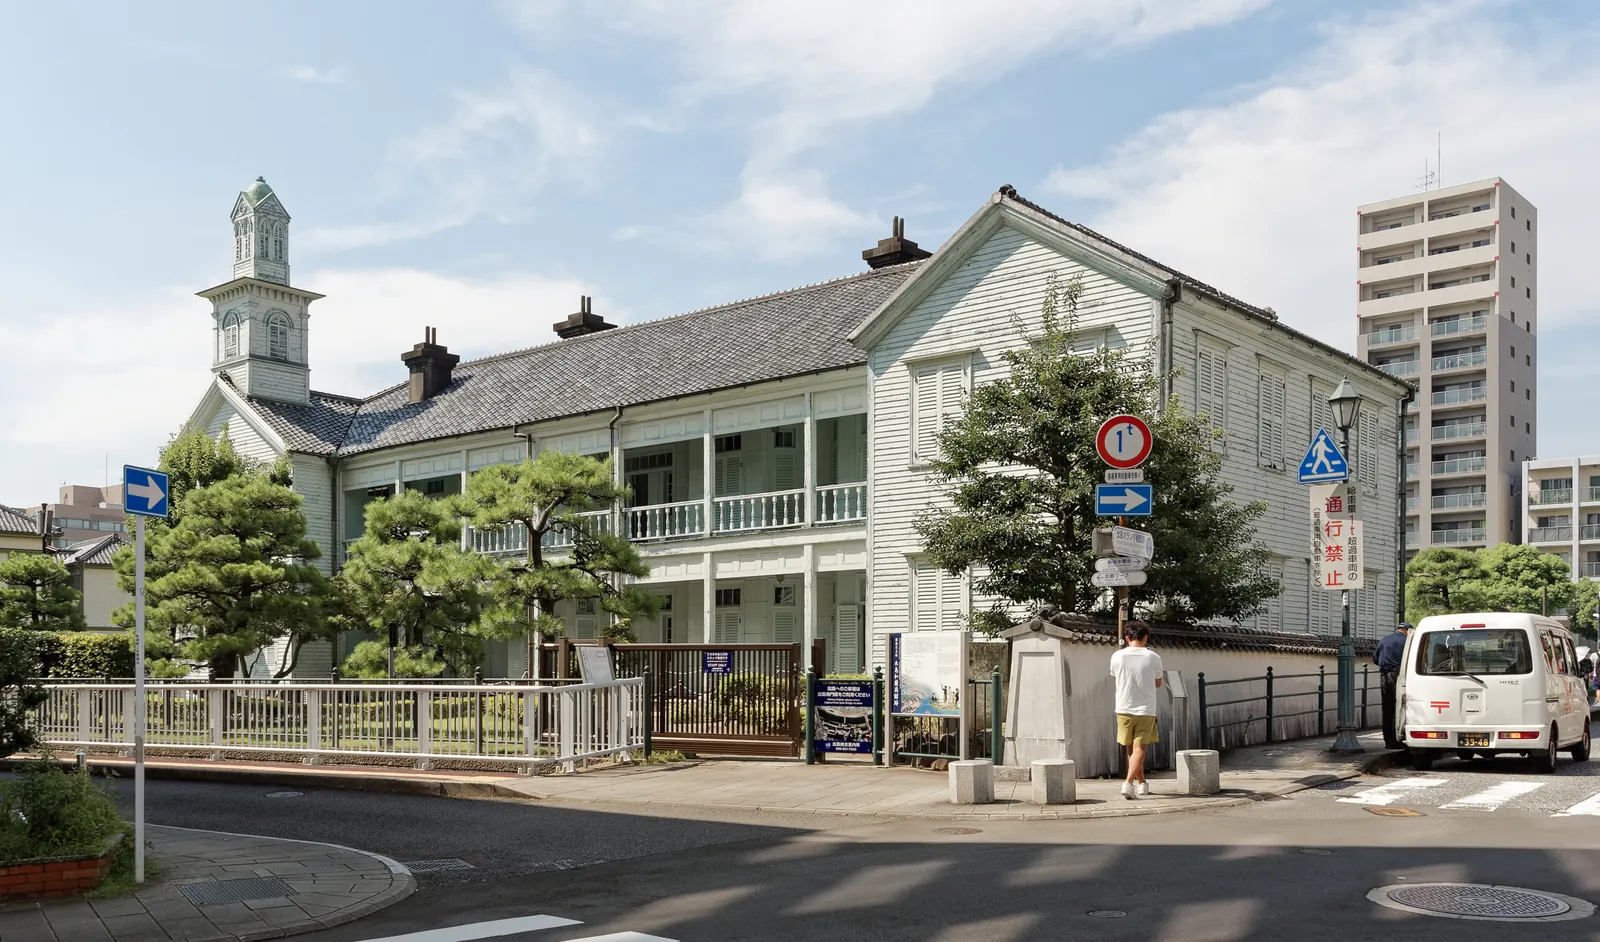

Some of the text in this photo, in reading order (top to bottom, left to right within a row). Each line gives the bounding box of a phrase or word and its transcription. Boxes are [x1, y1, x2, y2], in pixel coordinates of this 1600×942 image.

[1325, 496, 1344, 587] 通行禁止
[1347, 487, 1358, 581] 総重量1t超過車両の
